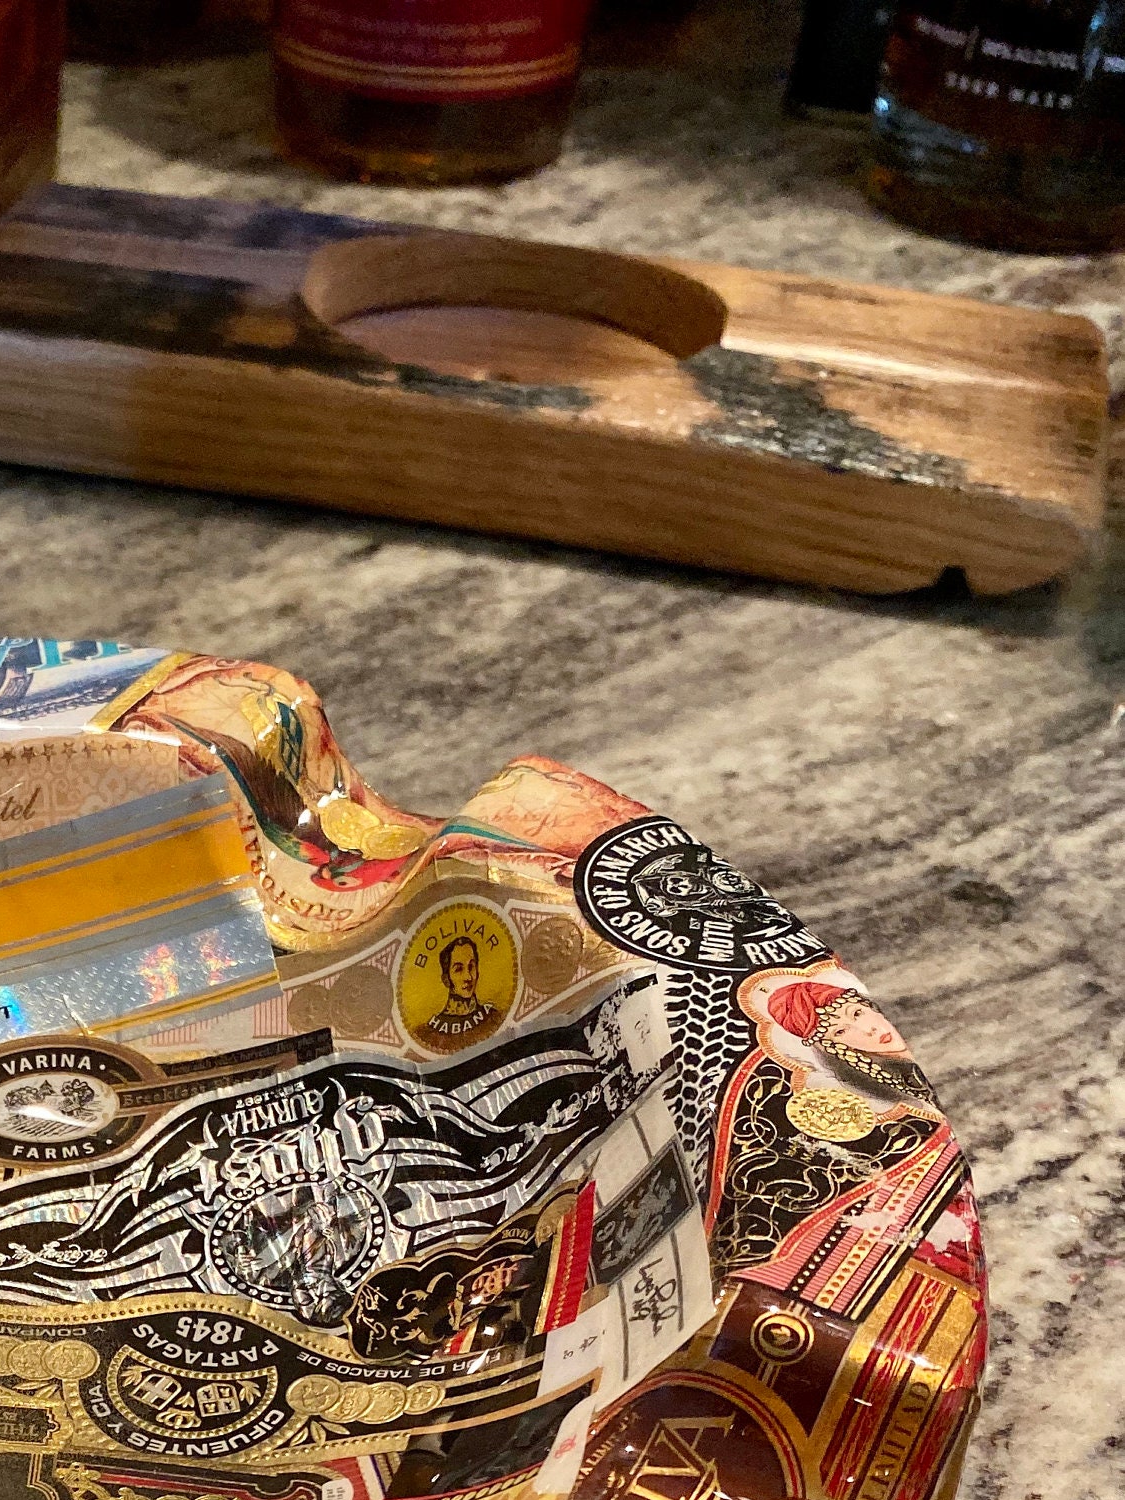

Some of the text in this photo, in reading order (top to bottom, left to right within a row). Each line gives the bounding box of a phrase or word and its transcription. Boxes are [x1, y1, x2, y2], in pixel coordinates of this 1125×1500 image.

[592, 886, 632, 909] OF
[415, 919, 499, 968] BOLIVAR
[610, 911, 693, 957] SONS
[428, 1002, 493, 1034] HABANA
[2, 1053, 92, 1077] VARINA
[217, 1086, 330, 1137] GURKHA
[12, 1141, 95, 1160] FARMS
[176, 1317, 245, 1343] 1845
[132, 1323, 281, 1367] PARTAGAS
[296, 1351, 321, 1367] DE
[325, 1361, 412, 1379] TABACOS
[419, 1366, 444, 1378] DE
[106, 1421, 121, 1436] Y
[127, 1409, 285, 1456] CIFUENTES
